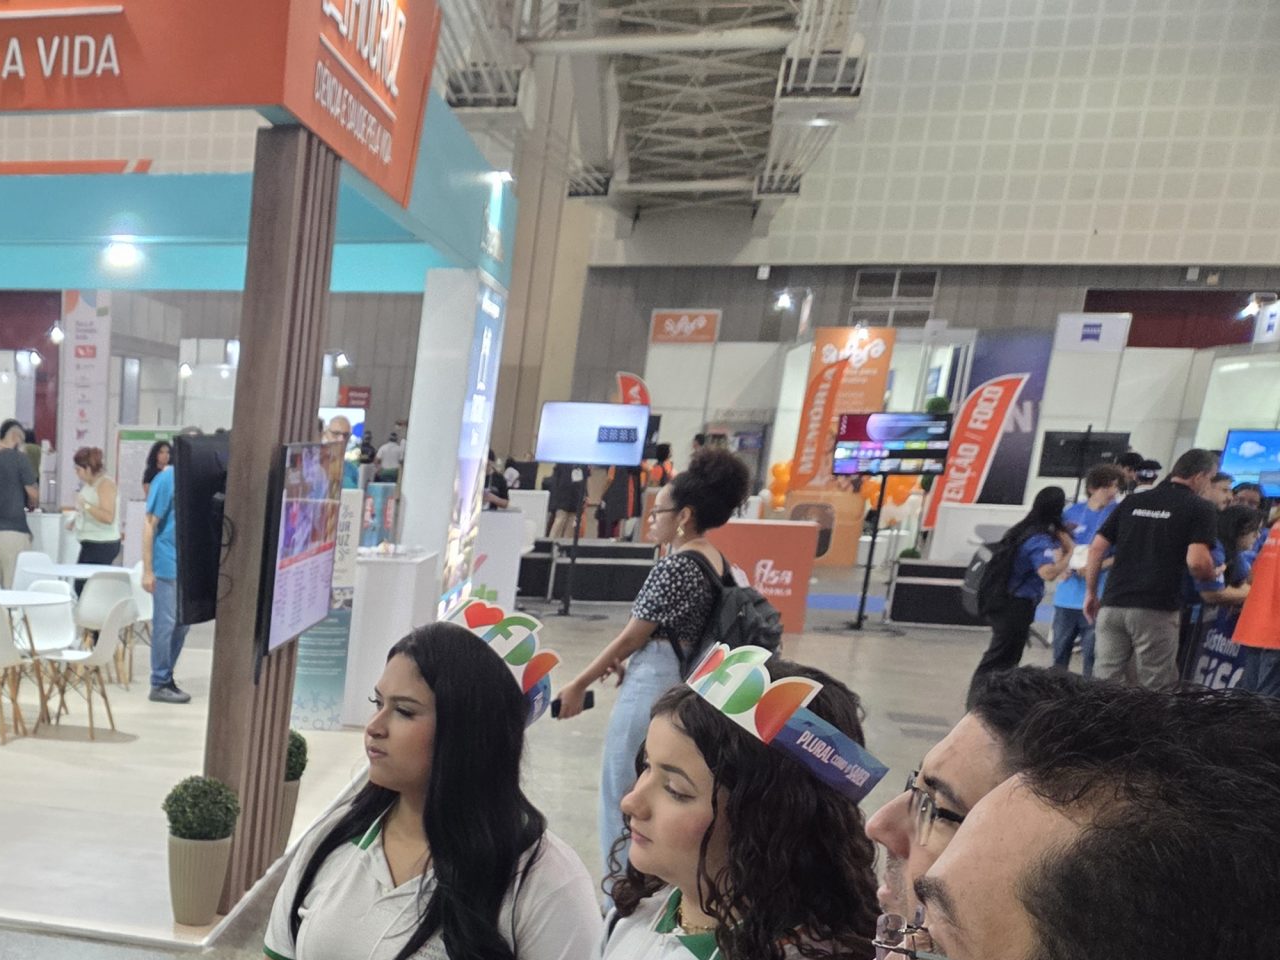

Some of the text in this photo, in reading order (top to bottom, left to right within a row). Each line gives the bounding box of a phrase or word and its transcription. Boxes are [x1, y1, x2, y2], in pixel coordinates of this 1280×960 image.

[36, 34, 120, 77] VIDA
[943, 442, 980, 500] ENÇÃO
[1132, 508, 1172, 519] PRODUÇÃO
[796, 730, 835, 763] PLURAL
